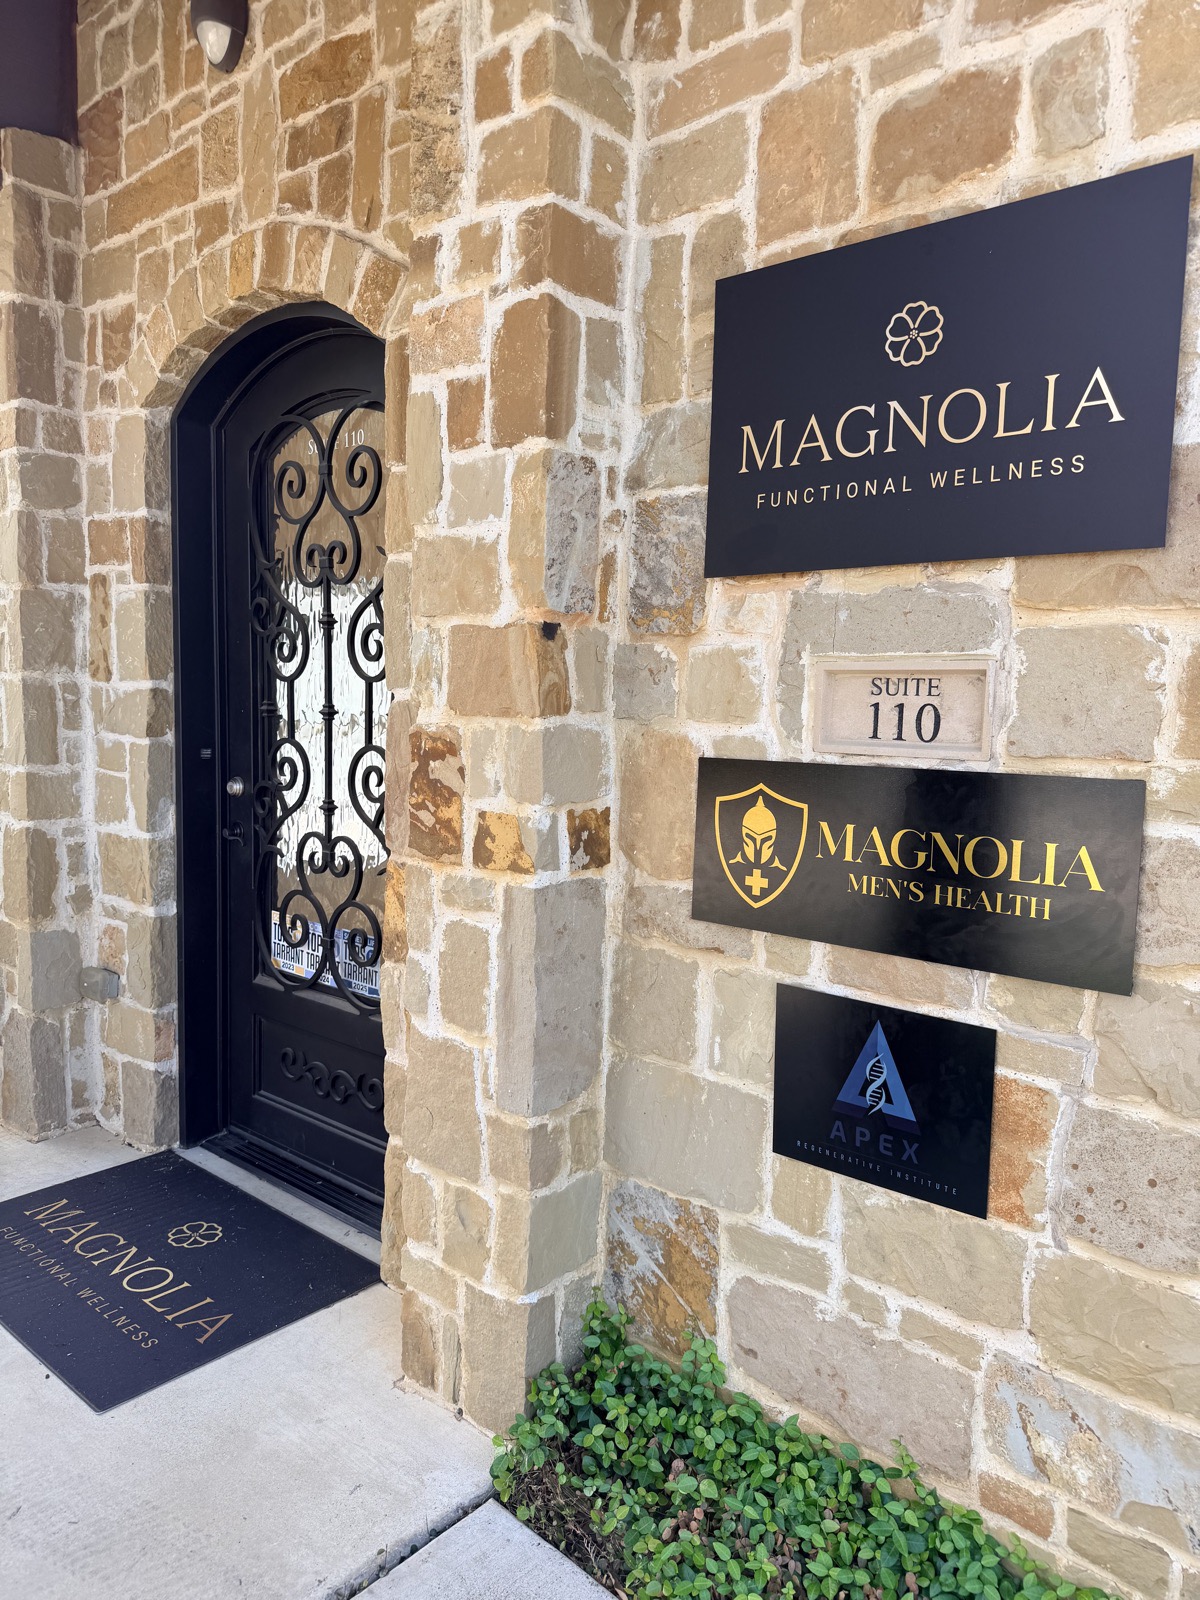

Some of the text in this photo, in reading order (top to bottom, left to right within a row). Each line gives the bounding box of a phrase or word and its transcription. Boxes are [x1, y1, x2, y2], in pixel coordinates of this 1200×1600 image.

[344, 428, 365, 448] 110
[738, 366, 1125, 474] MAGNOLIA
[757, 455, 1086, 509] FUNCTIONAL WELLNESS
[871, 677, 941, 698] SUITE
[868, 702, 941, 743] 110
[815, 820, 1105, 893] MAGNOLIA
[847, 873, 1051, 920] MEN'S HEALTH
[273, 941, 304, 966] TARRANT
[281, 961, 295, 972] 2023
[344, 961, 378, 988] TARRANT
[829, 1120, 920, 1164] APEX
[797, 1140, 958, 1195] REGENERATIVE INSTITUTE
[0, 1226, 159, 1349] FUNCTIONAL WELLNESS
[23, 1198, 234, 1344] MAGNOLIA
